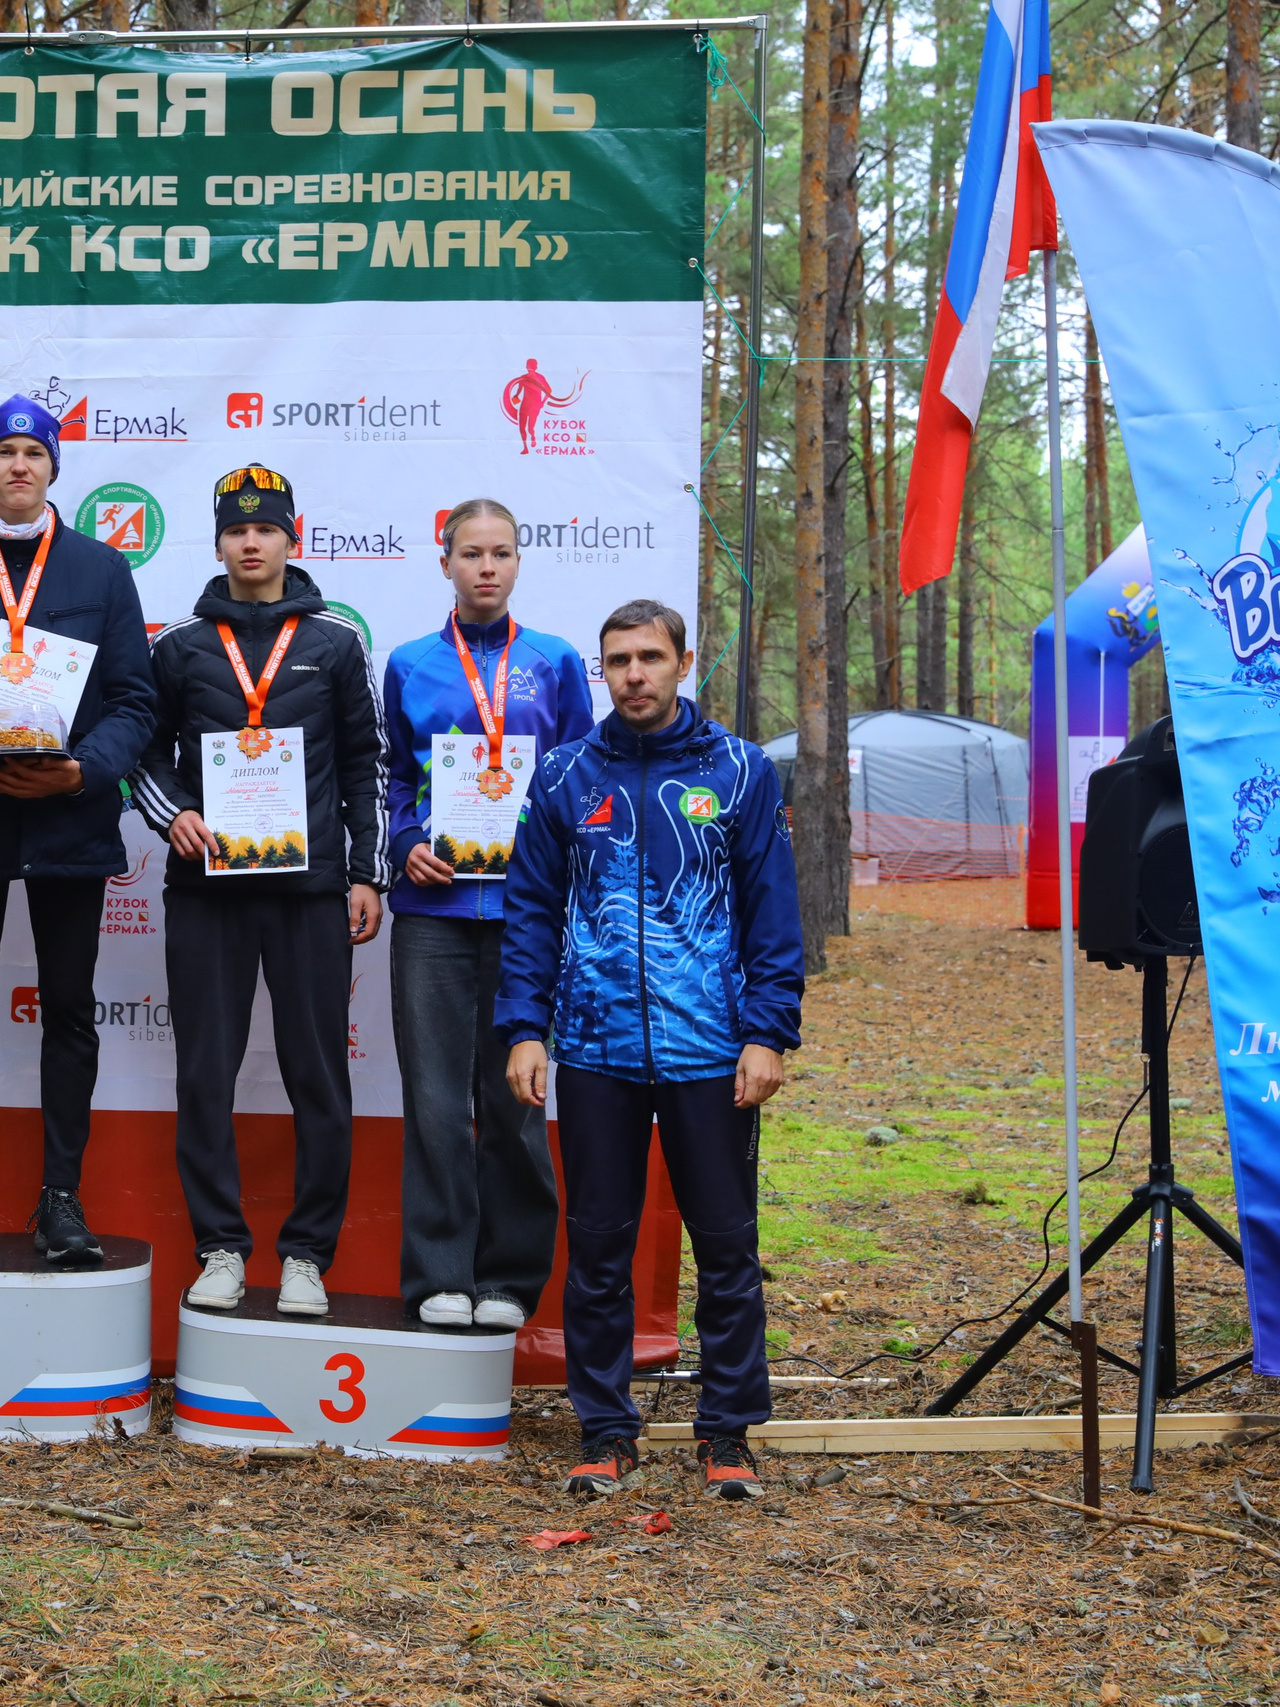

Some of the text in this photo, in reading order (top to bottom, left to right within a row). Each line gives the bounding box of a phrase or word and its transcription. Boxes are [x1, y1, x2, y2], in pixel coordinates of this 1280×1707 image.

[270, 68, 596, 136] ОСЕНЬ
[205, 170, 571, 207] СОРЕВНОВАНИЯ
[70, 225, 210, 273] КСО
[242, 219, 569, 270] «ЕРМАК»
[272, 395, 441, 427] SPORTident
[95, 408, 188, 443] Ермак
[543, 420, 586, 430] КУБОК
[344, 428, 407, 442] siberia
[543, 433, 570, 443] КСО
[535, 446, 595, 455] «ЕРМАК»
[79, 487, 161, 559] ФЕДЕРАЦИЯ СПОРТИВНОГО ОРИЕНТИРОВАНИЯ
[517, 516, 655, 549] ORTident
[311, 525, 405, 561] Ермак
[556, 550, 620, 564] siberia
[327, 605, 355, 619] ТИВНОГО
[20, 657, 28, 666] 1
[33, 665, 62, 681] ПЛОМ
[513, 694, 534, 702] ТРОПА
[257, 731, 267, 740] 3
[230, 767, 279, 778] ДИПЛОМ
[498, 773, 507, 782] 3
[106, 898, 148, 908] КУБОК
[106, 911, 133, 921] КСО
[99, 924, 157, 934] «ЕРМАК»
[129, 1030, 175, 1042] siber
[319, 1352, 366, 1424] 3
